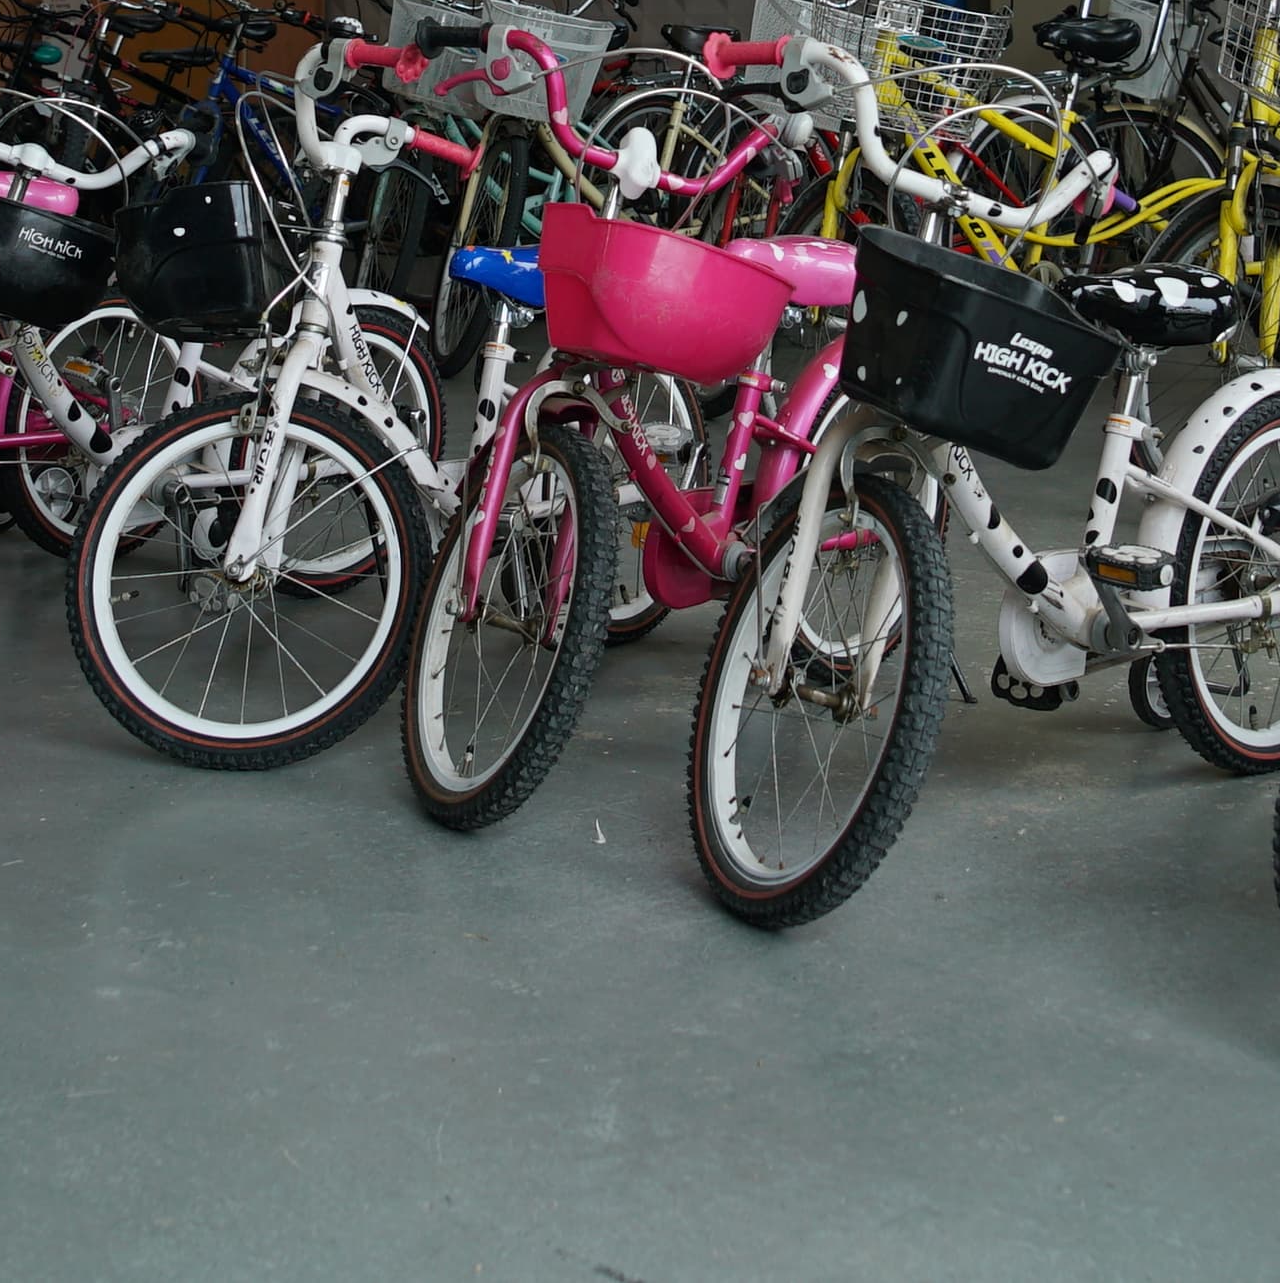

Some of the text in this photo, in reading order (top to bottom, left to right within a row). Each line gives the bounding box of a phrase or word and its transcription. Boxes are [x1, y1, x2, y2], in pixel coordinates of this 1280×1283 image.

[19, 226, 84, 260] HIGH KICK
[350, 323, 382, 395] HIGH KICK
[973, 341, 1026, 372] HIGH
[1023, 357, 1073, 395] KICK
[1010, 332, 1054, 360] Lespo
